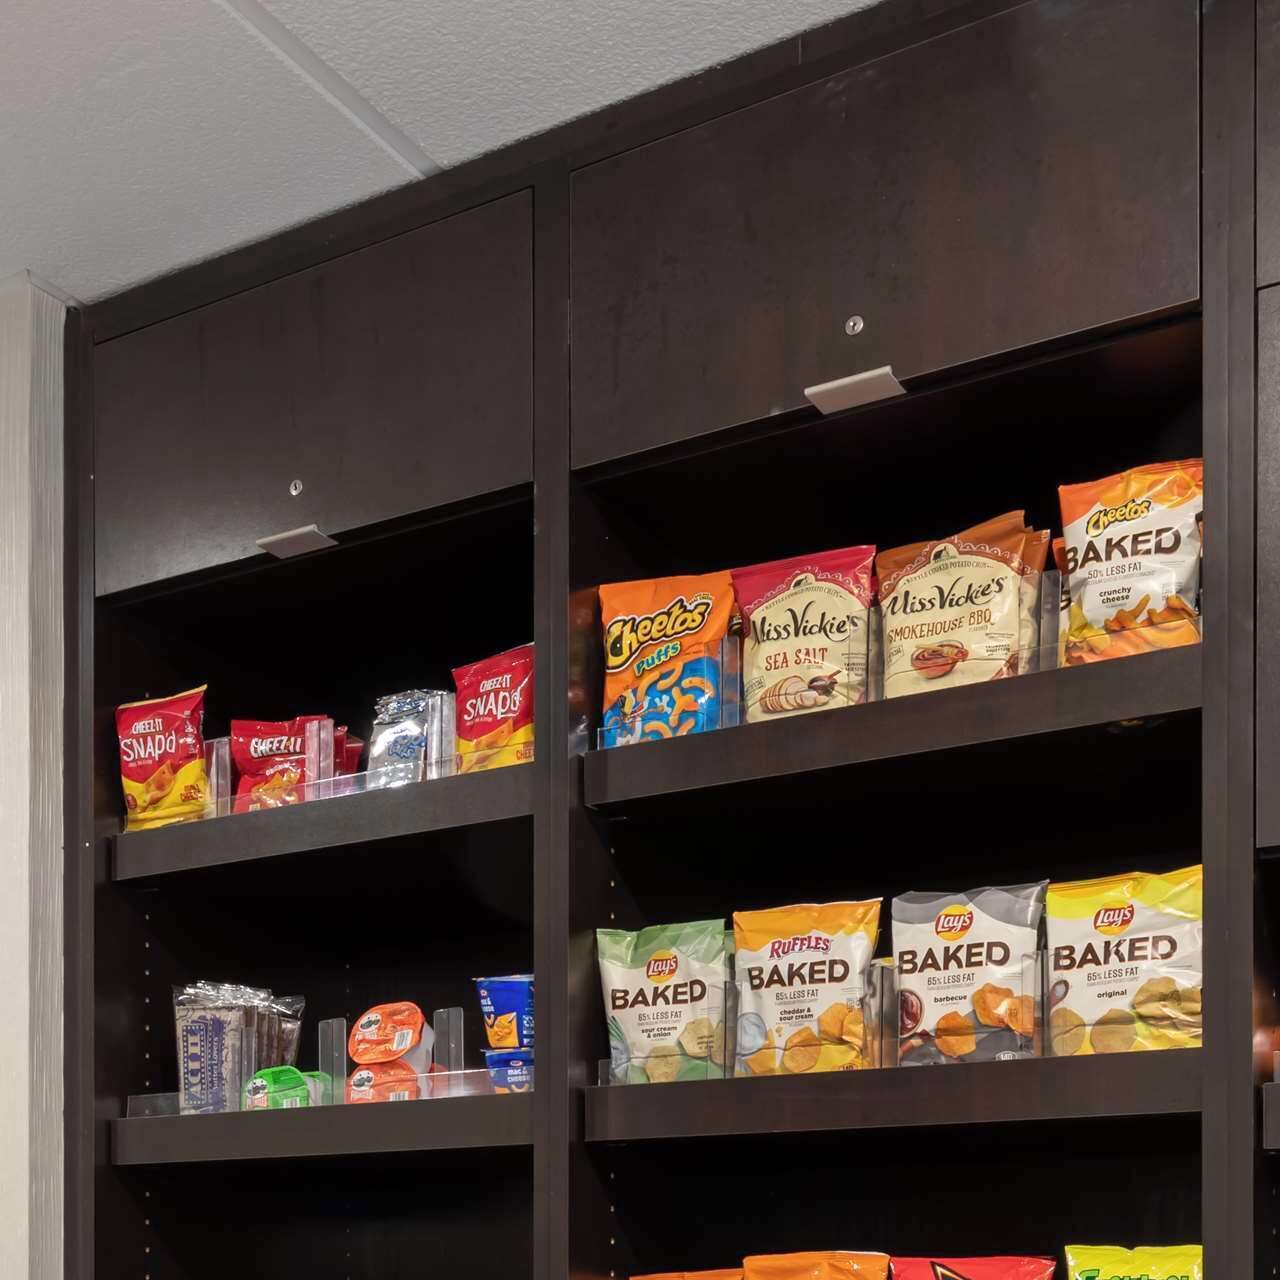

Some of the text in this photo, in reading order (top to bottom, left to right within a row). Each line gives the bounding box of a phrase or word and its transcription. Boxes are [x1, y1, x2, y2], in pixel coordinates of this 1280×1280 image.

[1086, 499, 1151, 538] Cheetos
[1105, 565, 1125, 577] LESS
[1128, 561, 1142, 574] FAT
[883, 576, 1008, 618] Miss Vickie's
[1099, 586, 1131, 598] crunchy
[1101, 594, 1130, 605] cheese
[606, 599, 712, 670] Cheetos
[888, 608, 993, 643] SMOKEHOUSE BBQ
[765, 648, 828, 671] SEA SALT
[770, 935, 832, 960] RUFFLES
[898, 941, 1010, 974] BAKED
[1053, 935, 1177, 971] BAKED
[648, 955, 678, 977] Lay's
[748, 959, 850, 990] BAKED
[1103, 970, 1123, 980] LESS
[1125, 967, 1139, 977] FAT
[943, 974, 961, 984] LESS
[962, 973, 975, 982] FAT
[611, 979, 707, 1010] BAKED
[789, 990, 806, 1000] LESS
[807, 989, 819, 998] FAT
[933, 994, 967, 1003] barbecue
[1097, 989, 1127, 999] original
[652, 1010, 682, 1021] LESS FAT
[780, 1007, 806, 1016] cheddar
